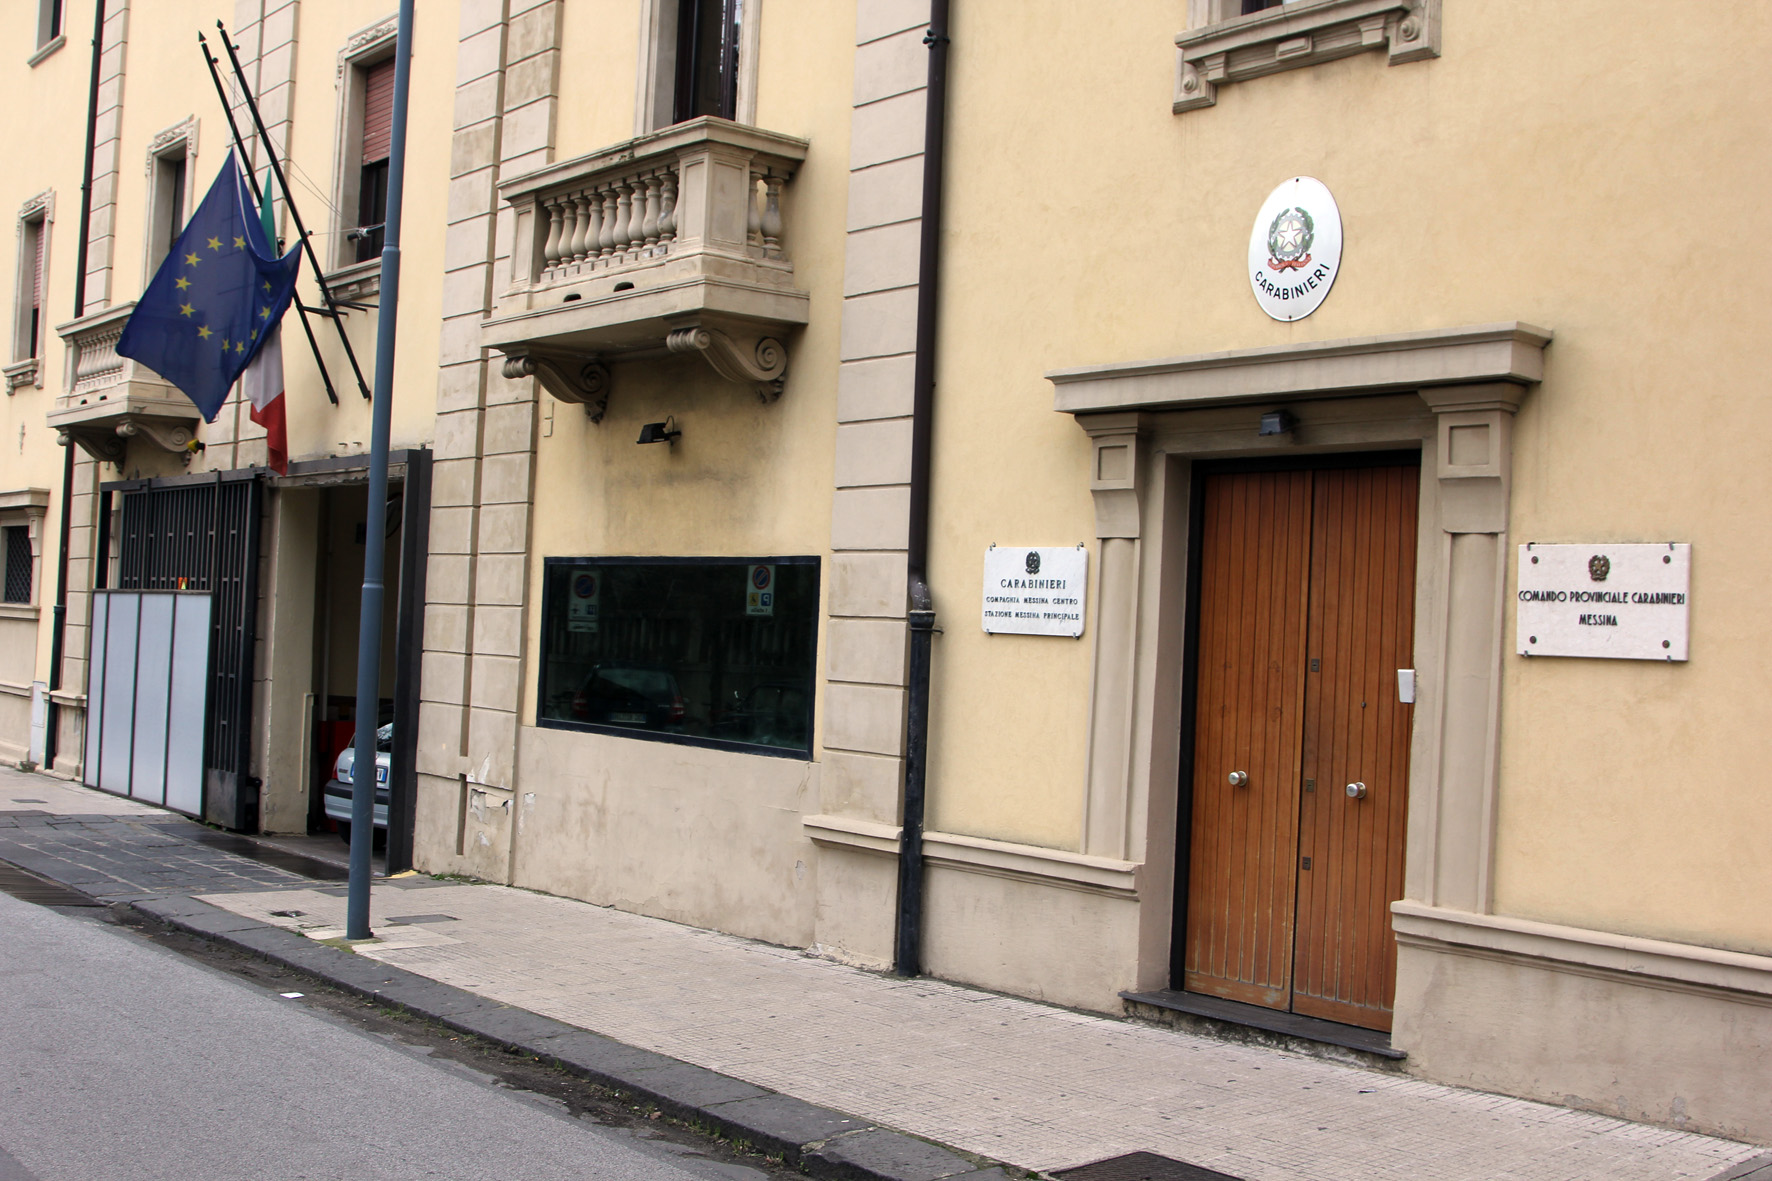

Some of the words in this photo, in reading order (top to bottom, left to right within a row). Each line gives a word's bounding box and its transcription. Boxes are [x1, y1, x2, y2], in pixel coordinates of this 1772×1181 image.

[1255, 263, 1330, 300] CARABINIERI
[1000, 578, 1066, 589] CARABINIERI
[1518, 590, 1567, 602] COMANDO
[1569, 591, 1629, 604] PROVINCIALE
[1631, 592, 1686, 605] CARABINIERI
[1015, 611, 1040, 619] MESSINA
[1043, 612, 1079, 620] PRINCIPALE
[1579, 613, 1618, 626] MESSINA
